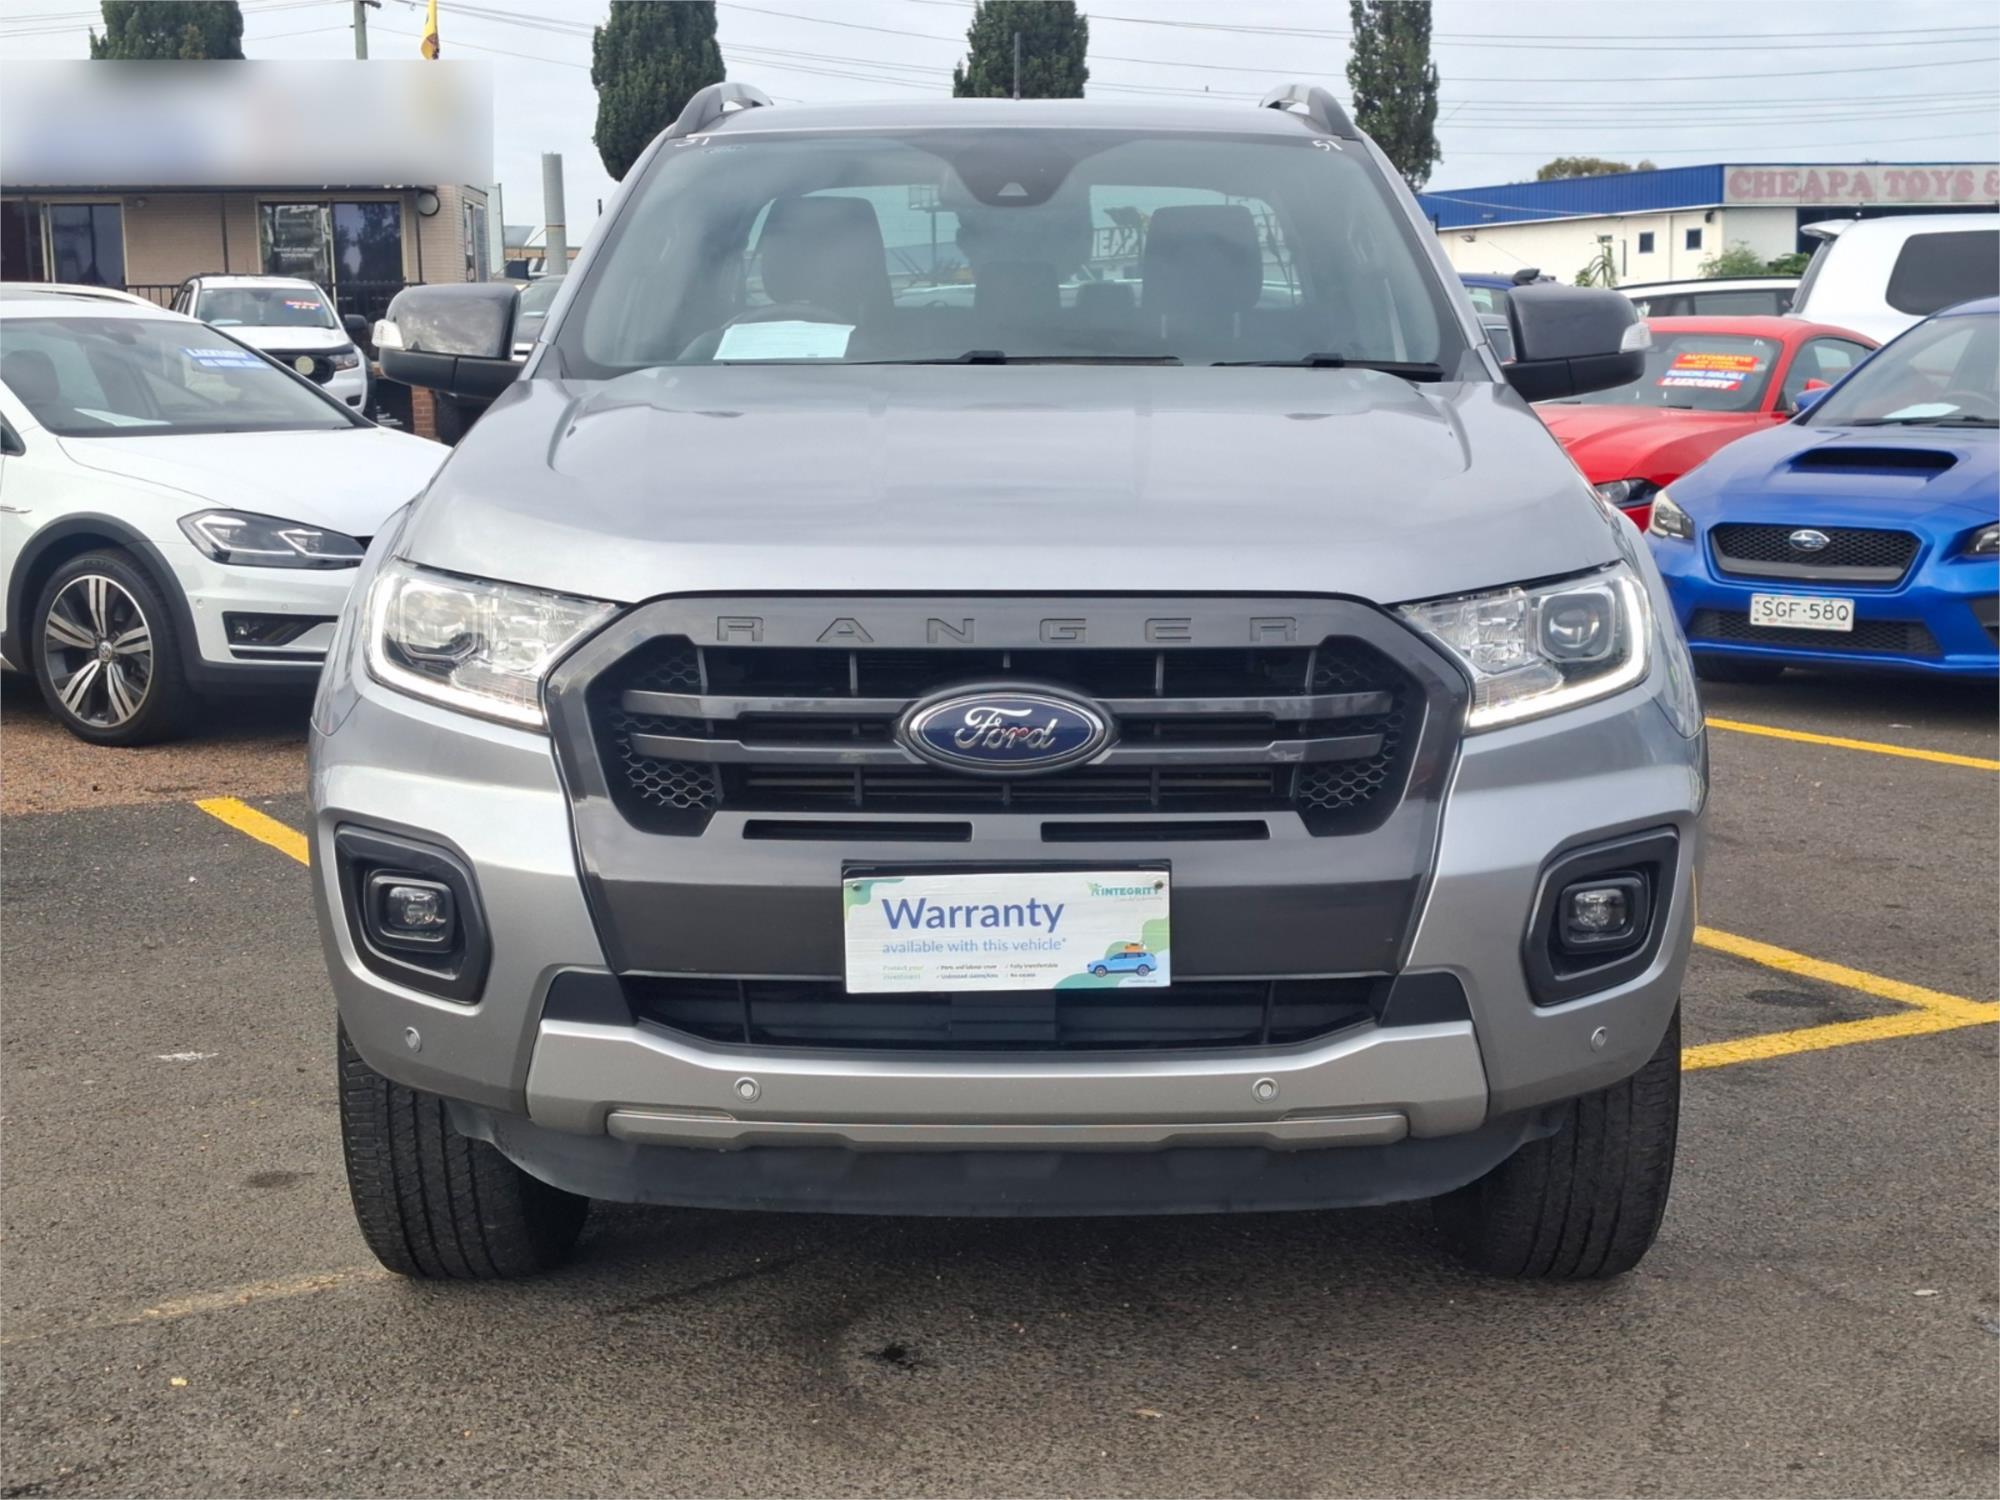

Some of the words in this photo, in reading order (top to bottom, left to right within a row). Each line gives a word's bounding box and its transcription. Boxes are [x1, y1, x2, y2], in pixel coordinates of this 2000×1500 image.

[1728, 169, 1874, 199] CHEAPA
[1884, 169, 1975, 199] TOYS
[716, 615, 1298, 643] RANGER
[954, 706, 1058, 751] Ford
[882, 897, 1064, 933] Warranty
[882, 937, 944, 954] available
[949, 936, 979, 953] with
[983, 935, 1008, 952] this
